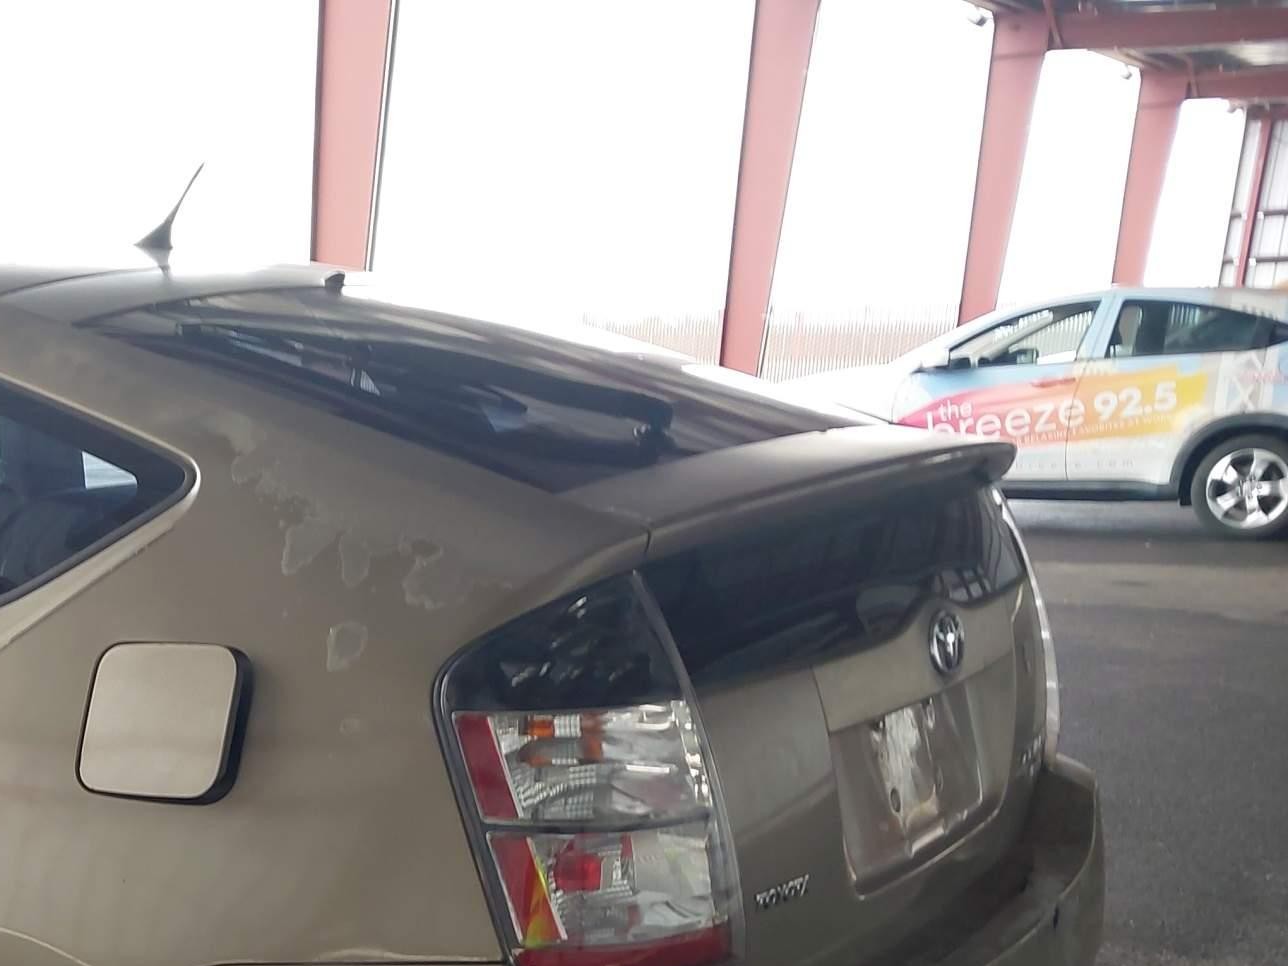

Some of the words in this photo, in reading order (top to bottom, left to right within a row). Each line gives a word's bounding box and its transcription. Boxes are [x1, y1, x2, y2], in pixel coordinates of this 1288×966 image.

[926, 397, 1086, 438] breeze
[1093, 383, 1178, 420] 92.5
[938, 403, 972, 421] the
